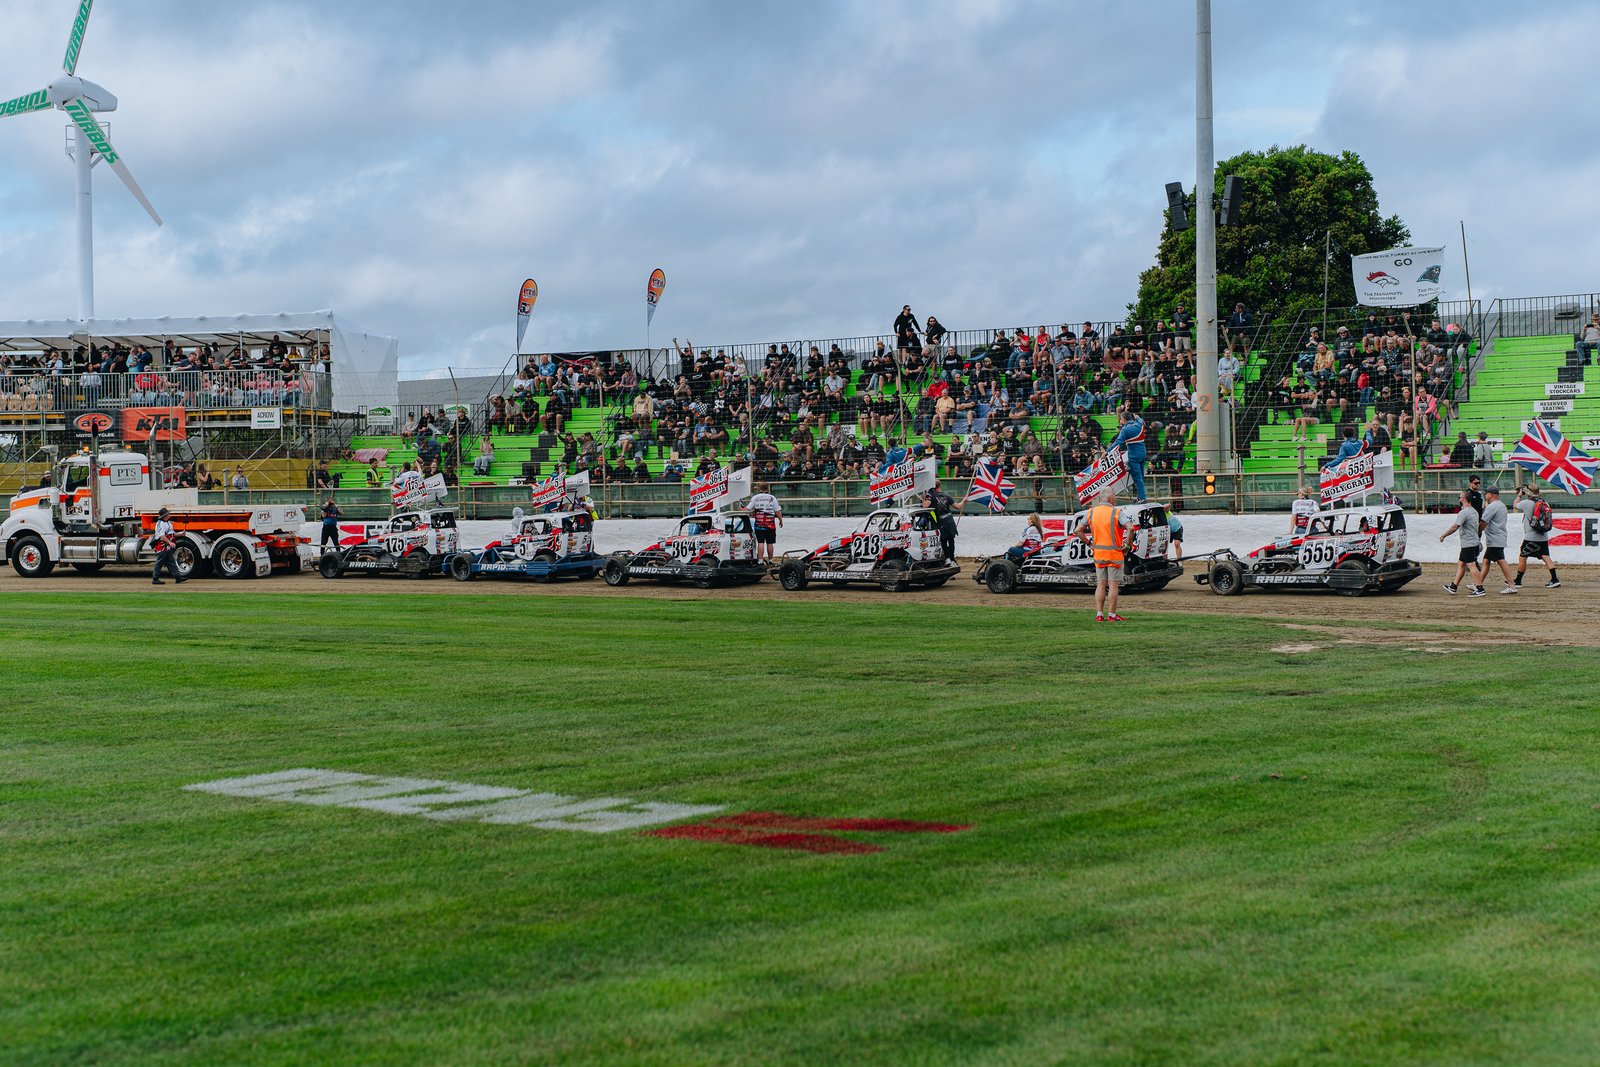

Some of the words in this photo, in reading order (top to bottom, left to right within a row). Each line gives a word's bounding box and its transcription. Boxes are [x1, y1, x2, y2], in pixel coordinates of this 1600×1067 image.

[64, 99, 119, 164] TURBOS
[1394, 258, 1412, 267] GO
[1199, 395, 1209, 411] 2
[136, 414, 179, 431] KTM
[257, 411, 275, 419] ACROW
[1100, 454, 1115, 472] 515
[1348, 460, 1364, 476] 555
[117, 468, 137, 477] PTS
[709, 472, 722, 485] 364
[894, 465, 907, 478] 213
[408, 479, 419, 491] 175
[554, 478, 559, 487] 5
[873, 486, 891, 497] HOLY
[891, 479, 912, 491] GRAIL
[1082, 482, 1101, 496] HOLY
[1100, 467, 1121, 484] GRAIL
[1324, 485, 1346, 497] HOLY
[1346, 477, 1371, 491] GRAIL
[692, 492, 707, 501] HOLY
[707, 485, 726, 496] GRAIL
[286, 510, 297, 518] PTS
[384, 538, 404, 553] 175
[519, 538, 526, 556] 5
[672, 540, 697, 558] 364
[853, 535, 881, 557] 213
[1302, 543, 1335, 564] 555
[812, 571, 843, 579] RAPID
